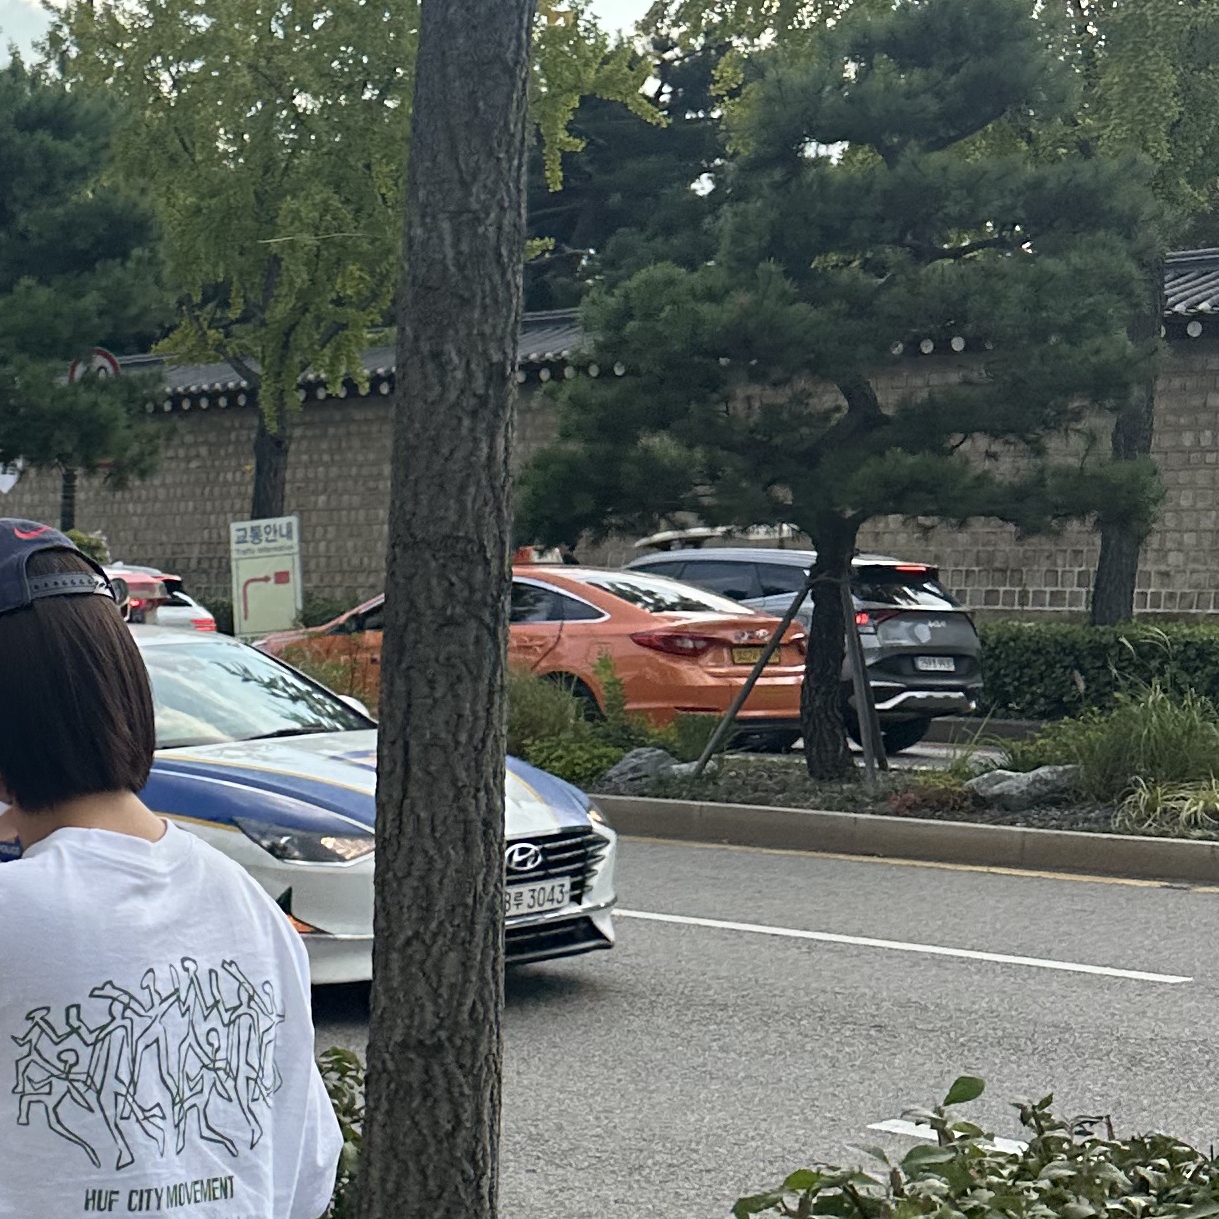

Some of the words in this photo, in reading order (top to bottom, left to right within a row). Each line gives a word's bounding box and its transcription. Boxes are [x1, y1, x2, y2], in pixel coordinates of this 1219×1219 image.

[235, 522, 294, 545] 교통안내
[527, 883, 565, 909] 3043
[84, 1188, 119, 1212] HUF
[127, 1187, 164, 1212] CITY
[166, 1175, 234, 1209] MOVEMENT
